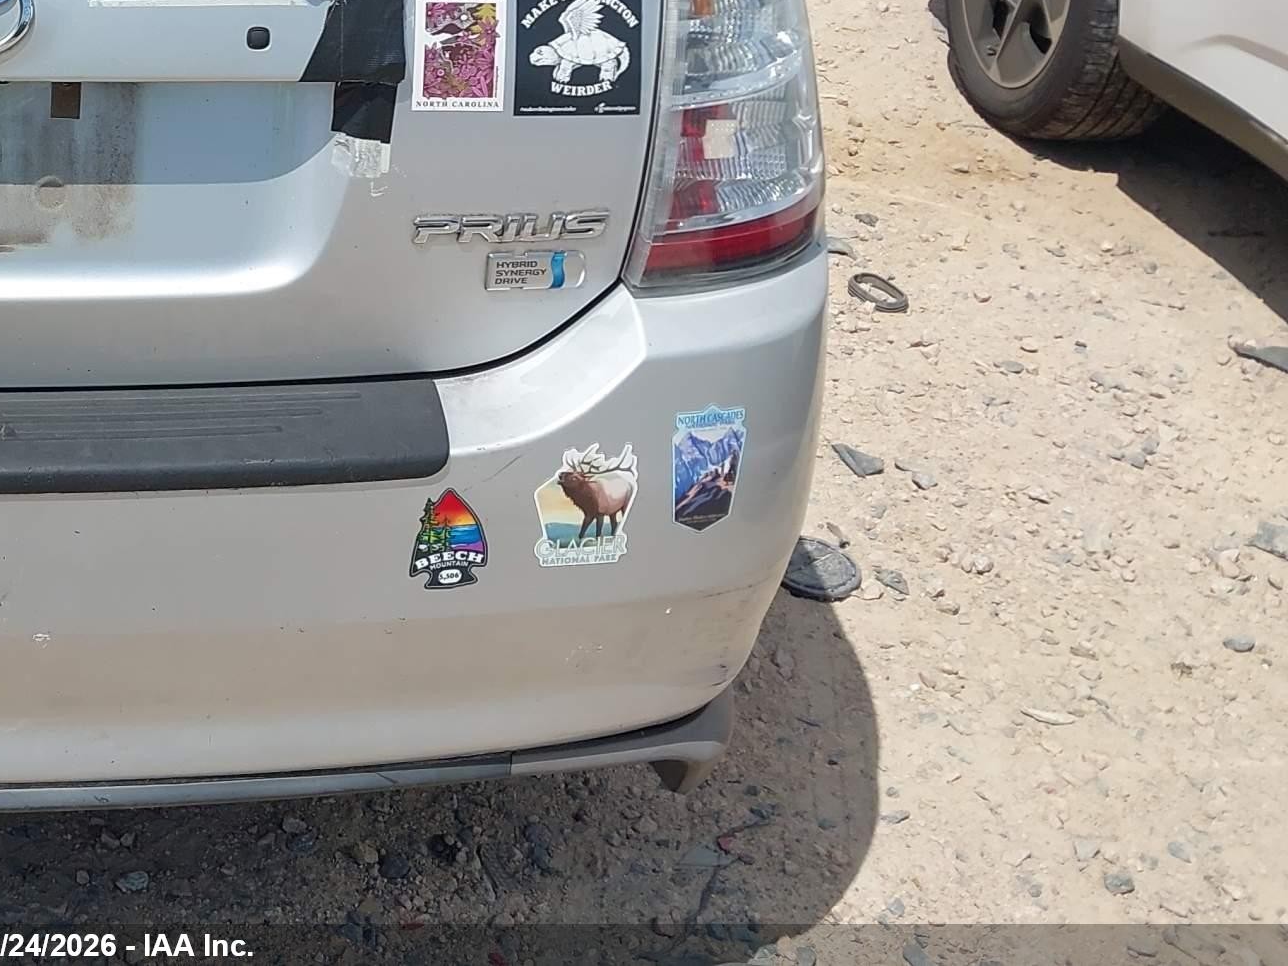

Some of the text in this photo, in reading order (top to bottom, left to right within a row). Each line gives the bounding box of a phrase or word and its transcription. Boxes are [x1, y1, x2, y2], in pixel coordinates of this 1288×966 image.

[551, 80, 613, 96] WEIRDER
[415, 100, 449, 108] NORTH
[413, 207, 611, 244] PRIUS
[496, 260, 538, 268] HYBRID
[537, 534, 625, 557] GLACIER
[415, 551, 484, 570] BEECH
[429, 560, 469, 570] MOUNTAIN
[542, 556, 590, 565] NATIONAL
